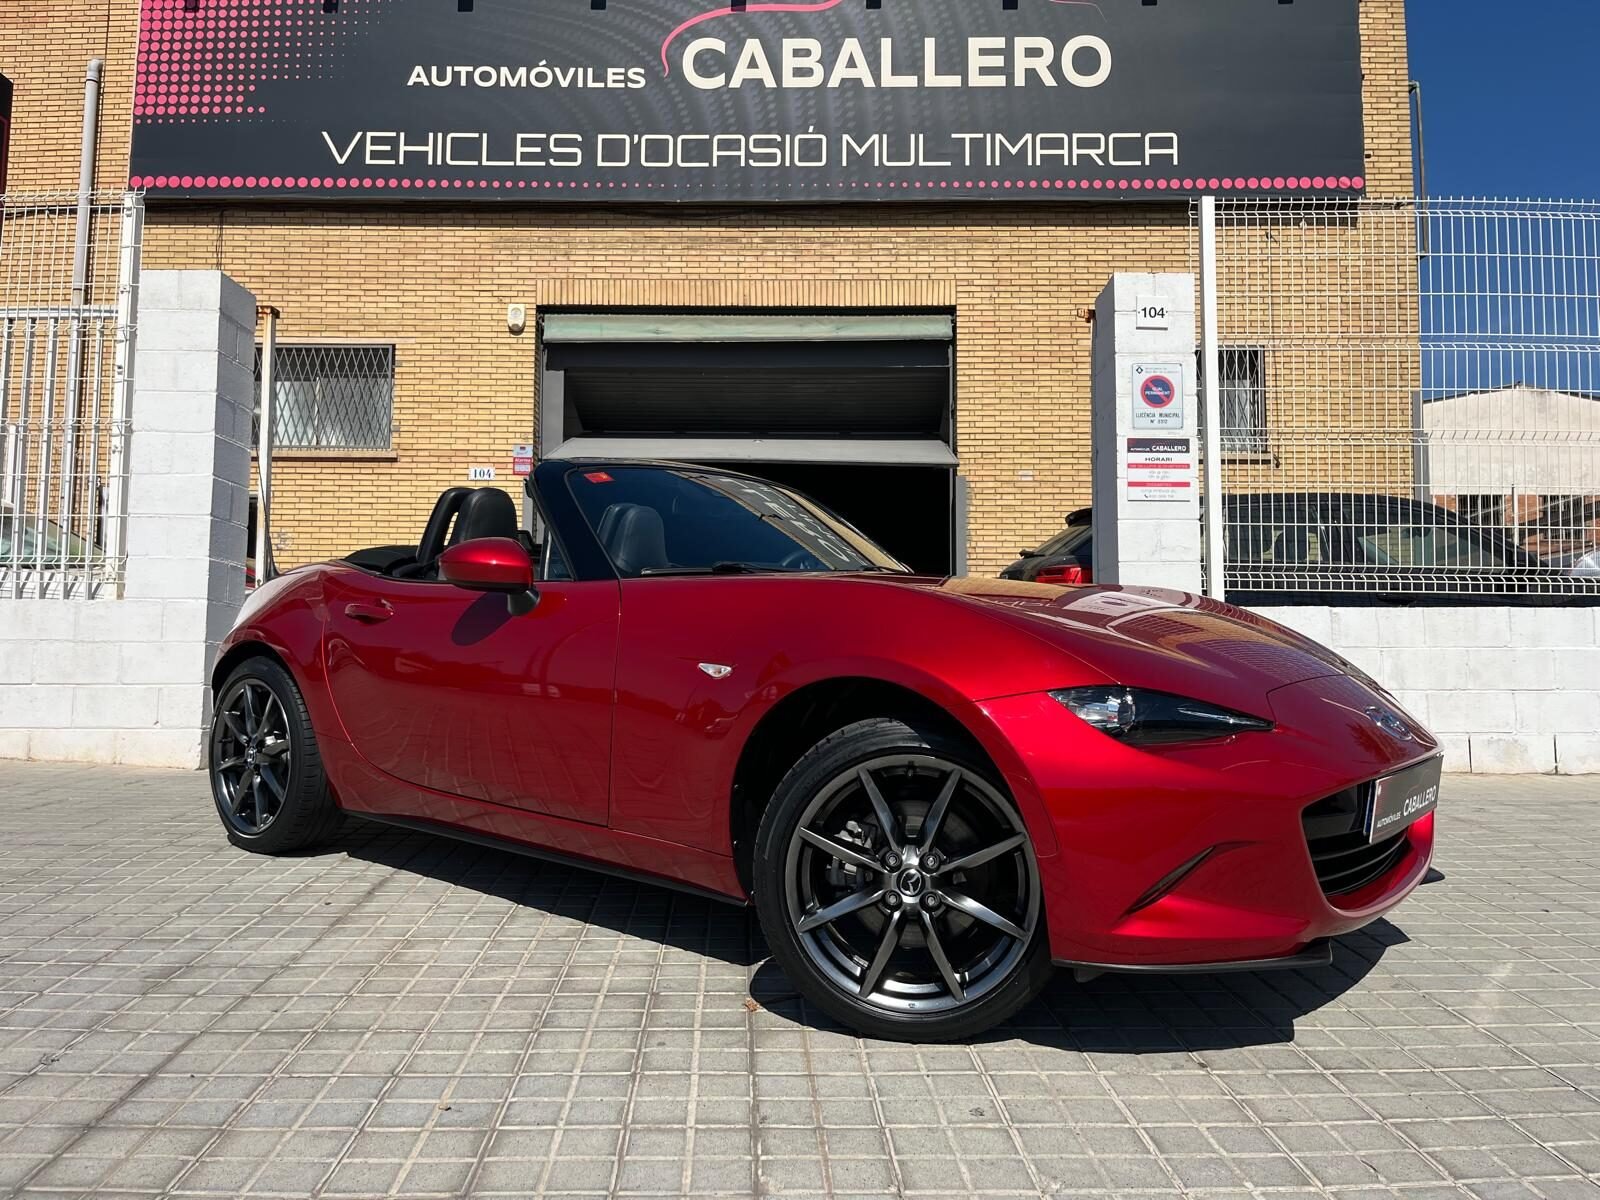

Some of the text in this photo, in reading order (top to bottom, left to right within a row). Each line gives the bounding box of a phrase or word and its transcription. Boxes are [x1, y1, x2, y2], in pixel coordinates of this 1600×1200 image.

[407, 35, 1112, 89] AUTOMÓVILES CABALLERO
[322, 126, 1178, 168] VEHICLES D'OCASIÓ MULTIMARCA
[1141, 306, 1166, 319] 104
[473, 469, 492, 479] 104
[1403, 785, 1436, 817] CABALLERO
